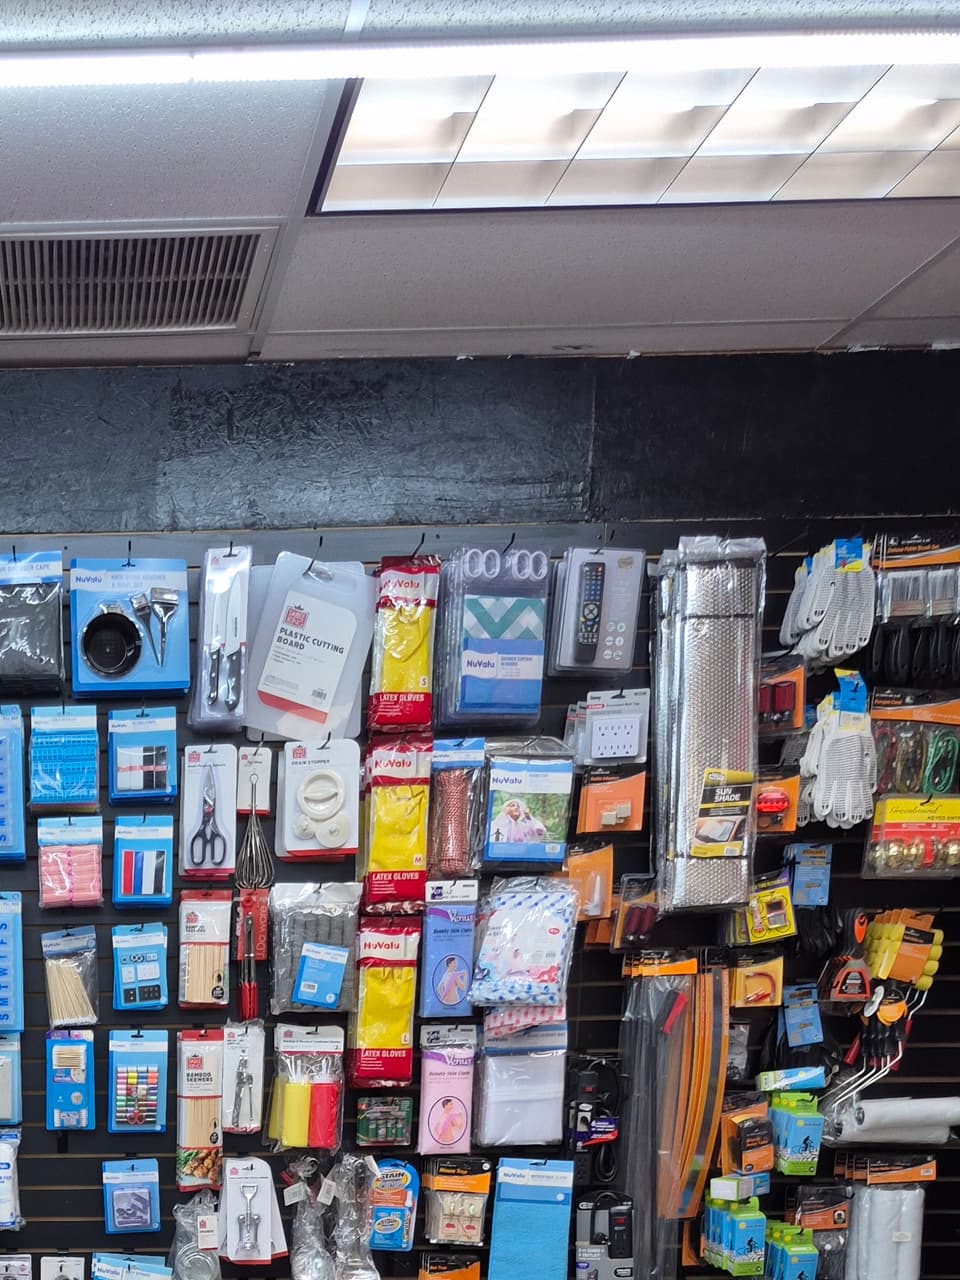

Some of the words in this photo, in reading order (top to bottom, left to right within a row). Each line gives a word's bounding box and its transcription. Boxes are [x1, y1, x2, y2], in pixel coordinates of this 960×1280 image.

[75, 575, 103, 585] NuValu
[276, 635, 305, 650] BOARD
[279, 627, 311, 643] PLASTIC
[311, 638, 344, 654] CUTTING
[466, 660, 496, 670] NuValu
[379, 692, 398, 701] LATEX
[373, 758, 412, 770] NuValu
[492, 776, 523, 785] NuValu
[715, 787, 733, 795] SUN
[714, 794, 741, 802] SHADE
[413, 856, 423, 865] M
[372, 872, 392, 881] LATEX
[393, 871, 419, 880] GLOVES
[448, 909, 474, 923] Venus
[363, 941, 401, 951] NuValu
[361, 1049, 381, 1058] LATEX
[381, 1049, 406, 1058] GLOVES
